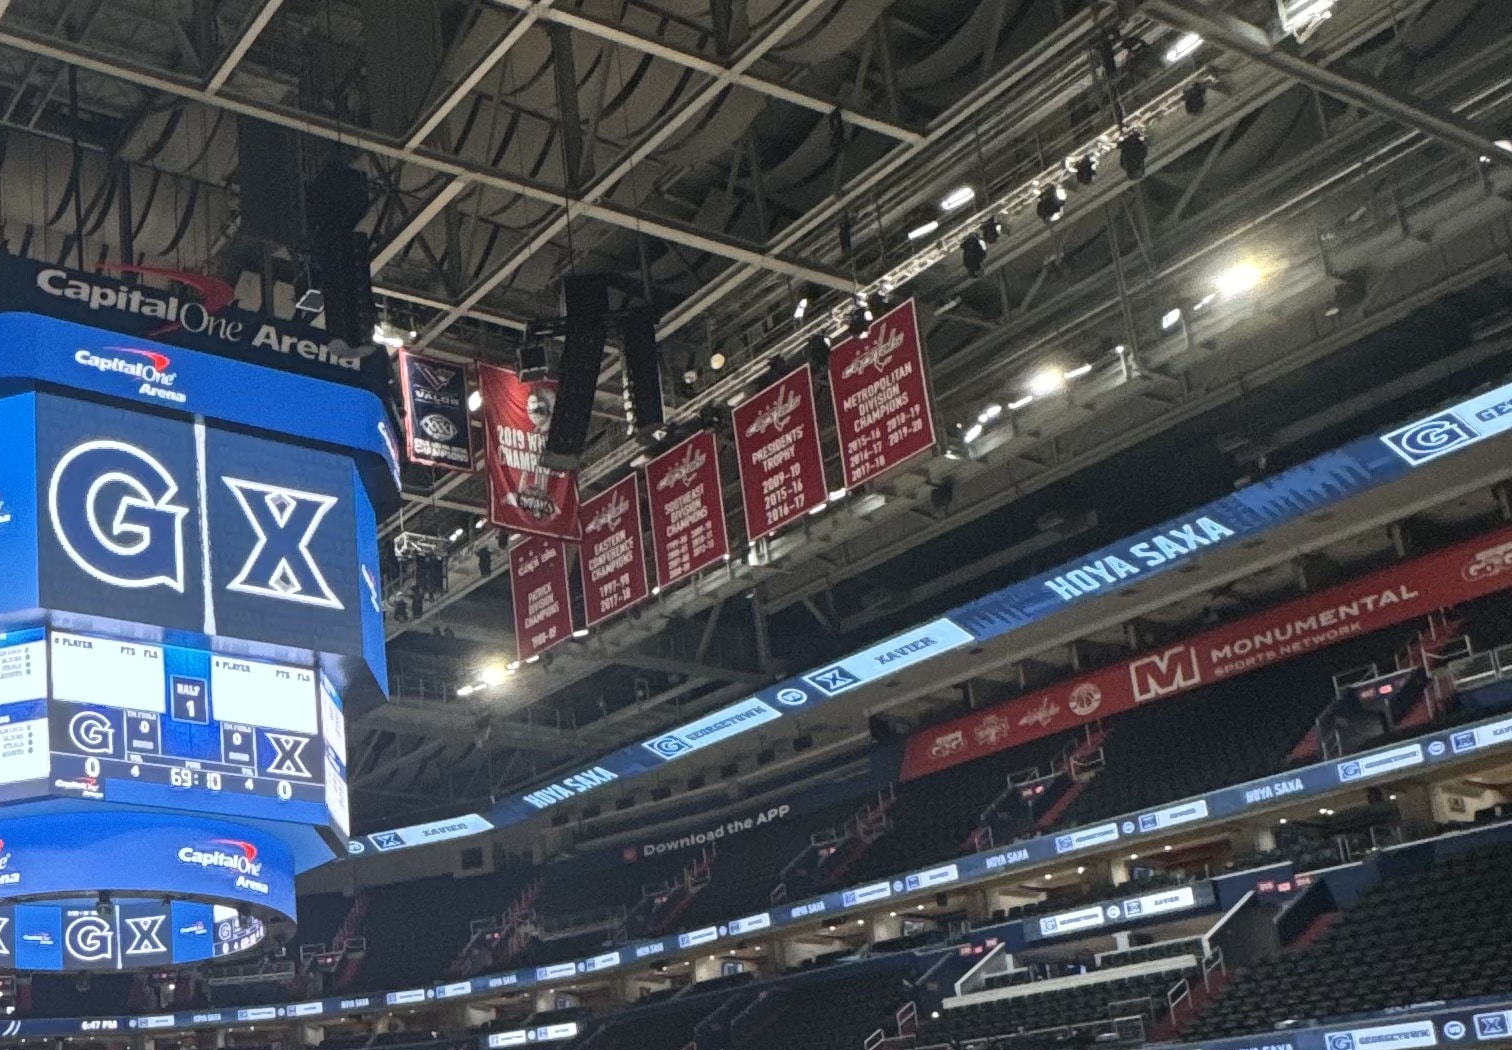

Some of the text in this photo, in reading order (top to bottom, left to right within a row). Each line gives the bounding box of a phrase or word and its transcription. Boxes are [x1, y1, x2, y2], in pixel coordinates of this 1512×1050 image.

[252, 324, 361, 371] Arena
[139, 383, 187, 402] Arena
[843, 361, 913, 413] METROPOLITAN
[858, 383, 900, 417] DIVISION
[854, 391, 909, 433] CHAMPIONS
[497, 425, 525, 448] 2019
[848, 427, 881, 453] 2015-16
[762, 444, 796, 473] TROPHY
[762, 463, 801, 495] 2009-10
[670, 496, 702, 523] DIVISION
[764, 480, 803, 510] 2015-16
[766, 493, 805, 525] 2016-17
[48, 440, 345, 610] G X
[666, 505, 708, 537] CHAMPIONS
[588, 536, 634, 571] CONFERENCE
[593, 529, 627, 555] EASTERN
[591, 551, 633, 582] CHAMPIONS
[1044, 517, 1236, 601] HOYA SAXA
[524, 601, 560, 629] CHAMPIONS
[62, 638, 93, 649] PLAYER
[121, 646, 136, 656] PTS
[873, 636, 938, 665] XAVIER
[1129, 584, 1419, 702] M MONUMENTAL
[1214, 620, 1363, 677] SPORTS NETWORK
[222, 661, 251, 673] PLAYER
[177, 684, 200, 696] HALF
[186, 701, 196, 718] 1
[69, 711, 115, 754] G
[140, 721, 149, 734] 0
[232, 733, 242, 746] 0
[85, 757, 100, 777] 0
[264, 732, 313, 778] X
[131, 765, 140, 777] 4
[170, 768, 221, 792] 69:10
[245, 778, 253, 790] 4
[278, 781, 292, 800] 0
[523, 766, 619, 809] HOYA SAXA
[1245, 778, 1304, 803] HOYA SAXA
[643, 805, 791, 857] Download the APP
[235, 875, 269, 894] Arena
[65, 914, 168, 960] G X
[81, 1020, 117, 1031] 6:47 PM
